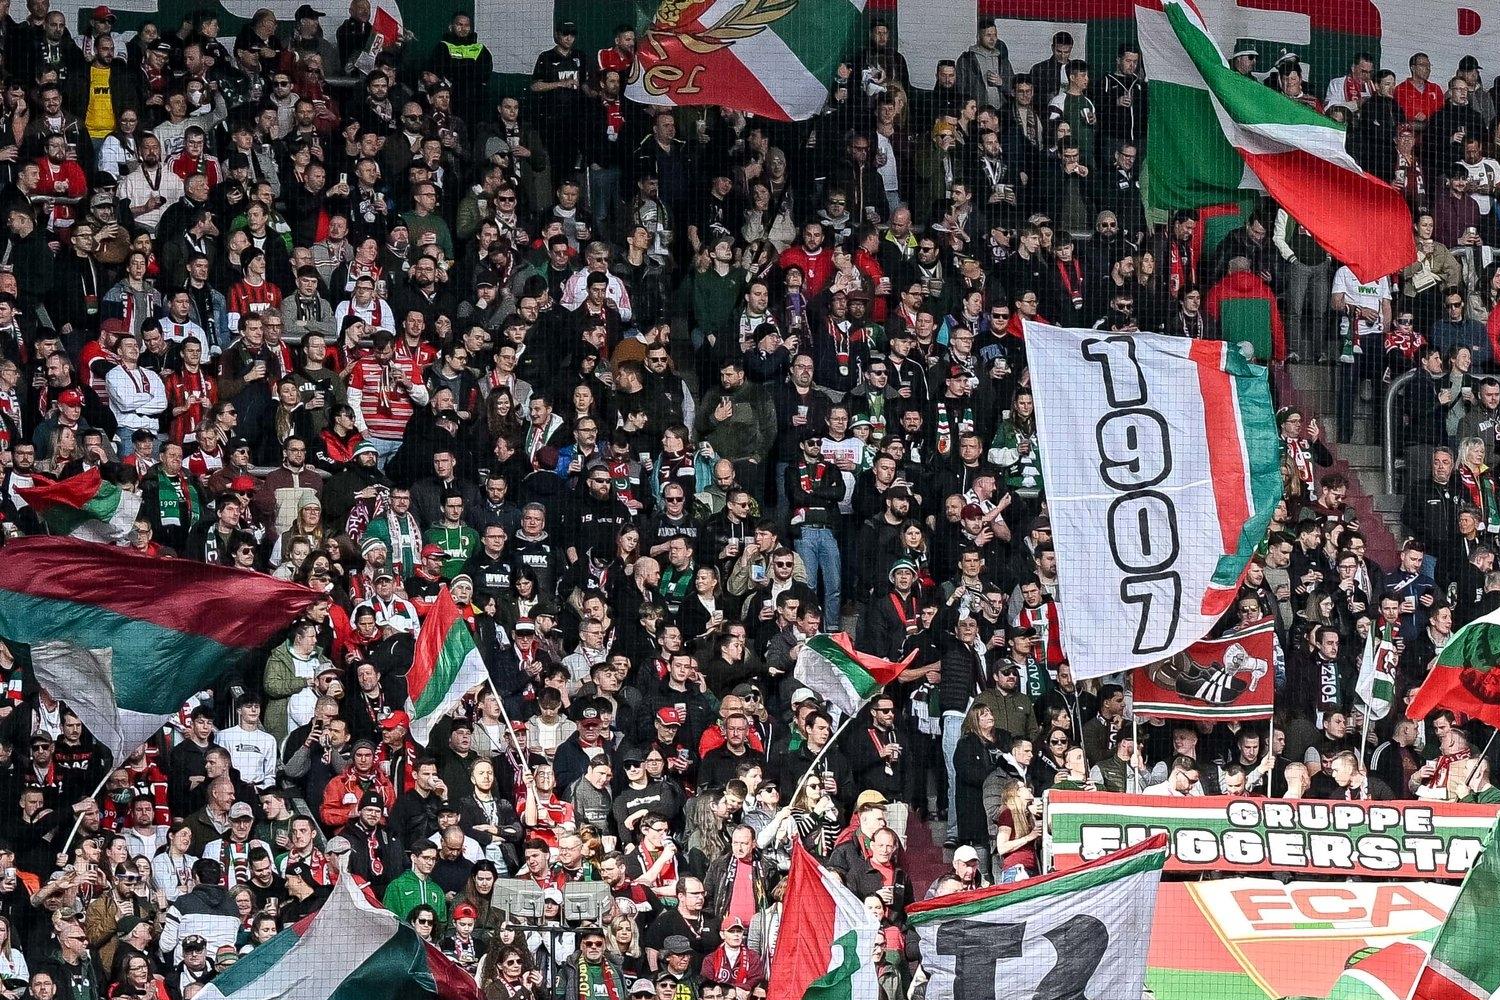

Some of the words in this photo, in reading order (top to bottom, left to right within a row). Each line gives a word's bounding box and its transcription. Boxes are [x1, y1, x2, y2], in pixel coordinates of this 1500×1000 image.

[1358, 285, 1378, 295] WWK
[1081, 335, 1181, 656] 1907
[206, 540, 218, 562] FC
[522, 554, 548, 563] WWK
[486, 573, 510, 583] WWK
[1321, 663, 1337, 704] FORZ
[104, 809, 117, 818] 907
[1227, 801, 1433, 834] GRUPPE
[1232, 885, 1448, 926] FCA
